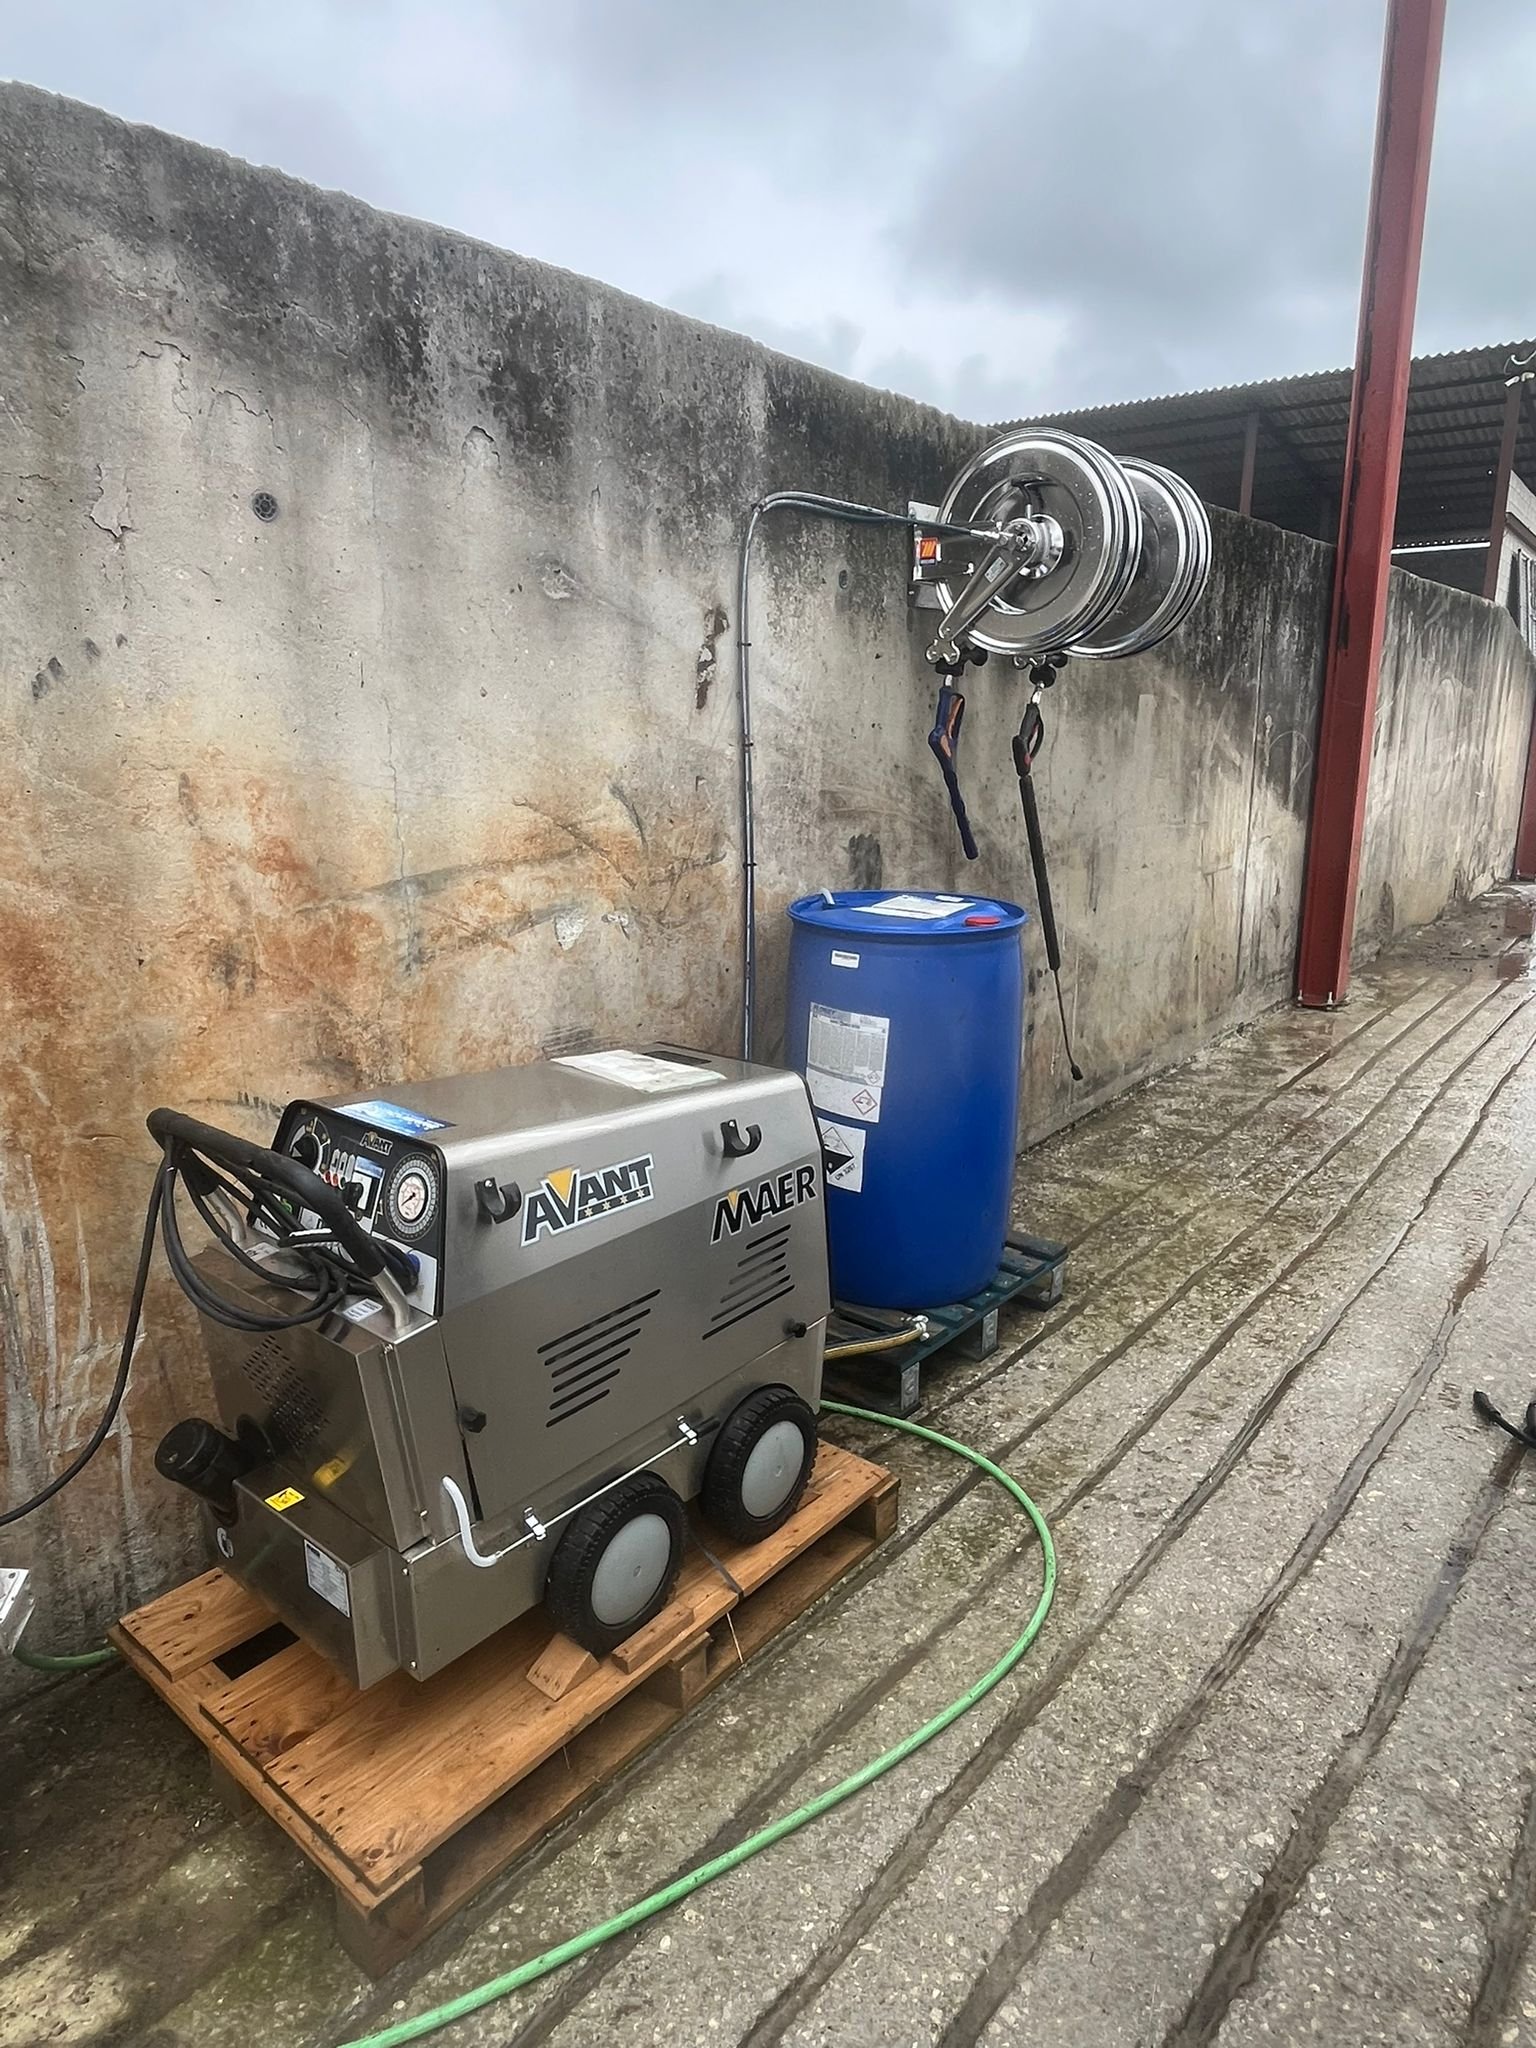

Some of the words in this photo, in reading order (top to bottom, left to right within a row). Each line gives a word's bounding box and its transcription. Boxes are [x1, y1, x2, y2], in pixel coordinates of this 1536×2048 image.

[360, 1132, 393, 1155] AVANT
[523, 1156, 652, 1243] AVANT
[712, 1165, 817, 1243] MAER
